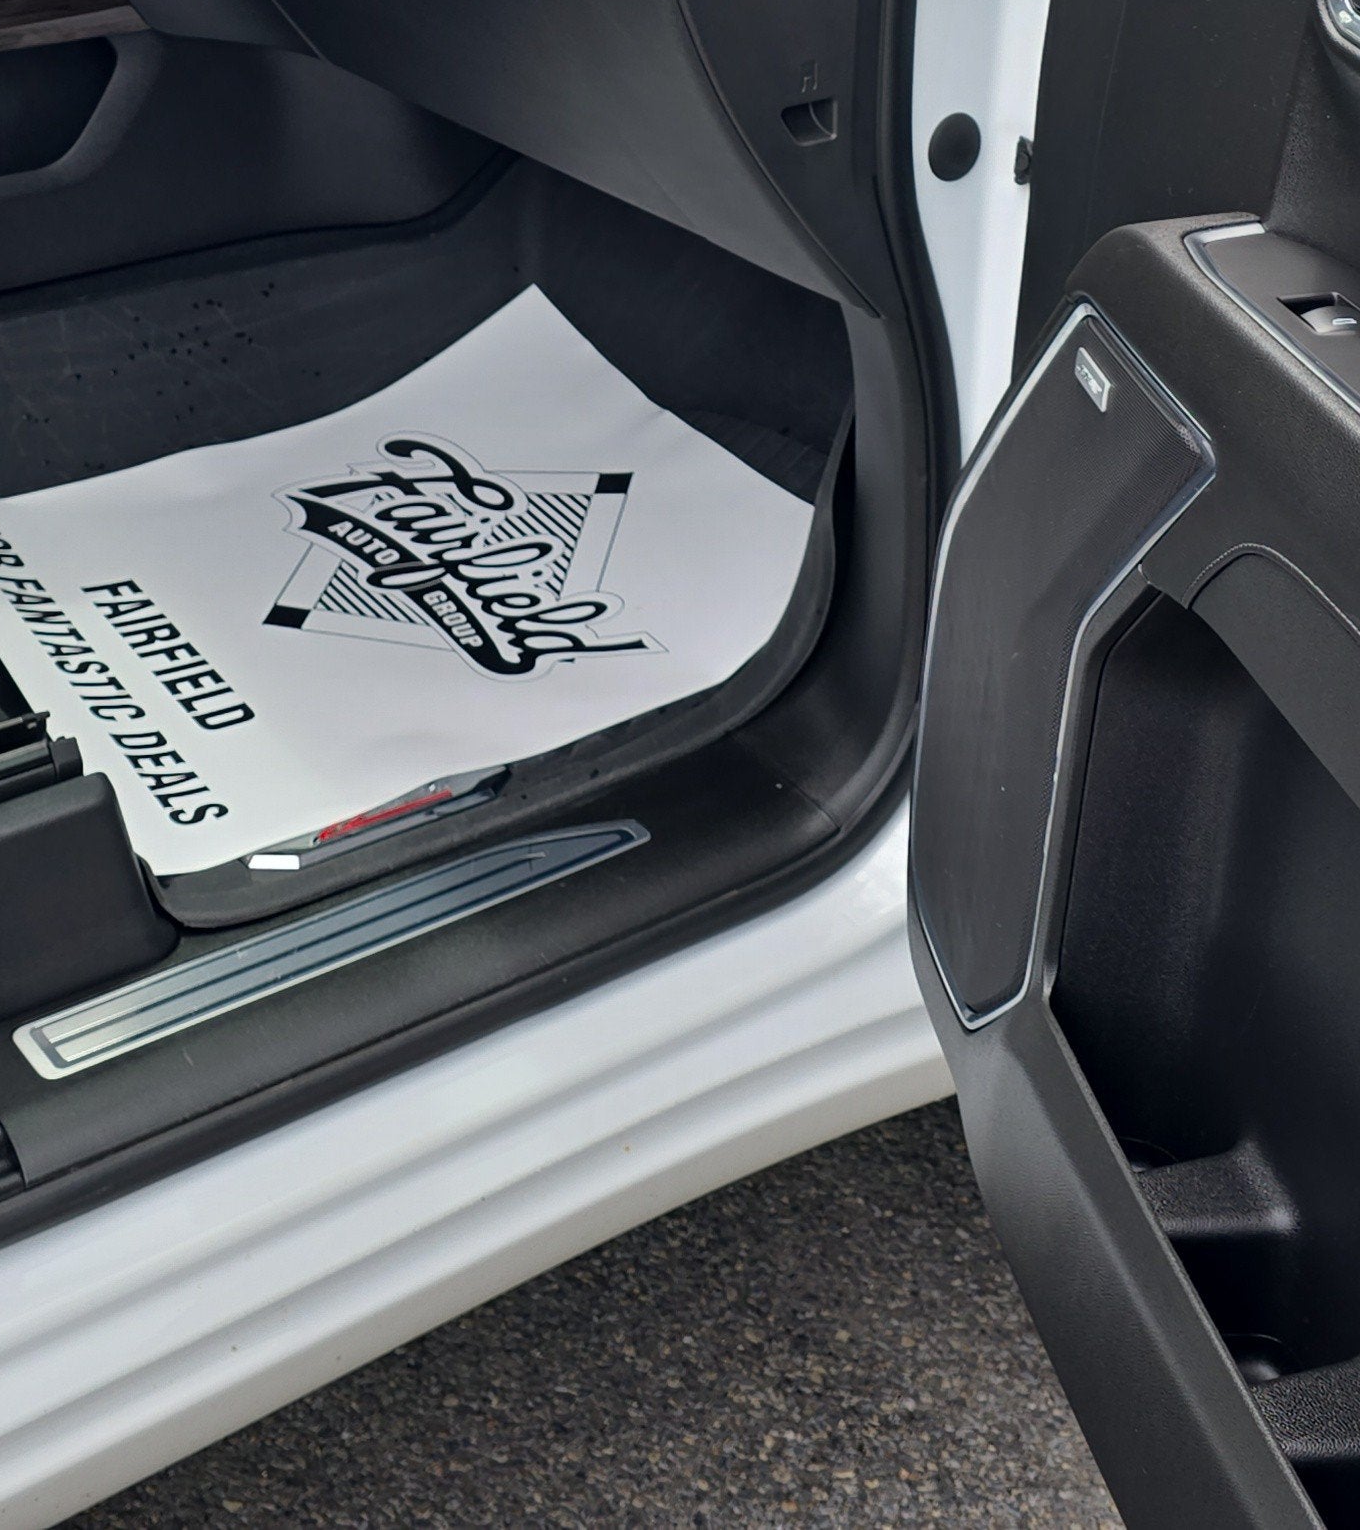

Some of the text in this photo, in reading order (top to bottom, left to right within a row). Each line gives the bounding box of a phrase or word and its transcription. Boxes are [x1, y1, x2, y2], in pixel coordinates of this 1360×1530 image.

[303, 439, 649, 653] Fairfield
[328, 520, 484, 648] AUTO GROUP
[81, 579, 256, 731] FAIRFIELD
[109, 731, 229, 826] DEALS
